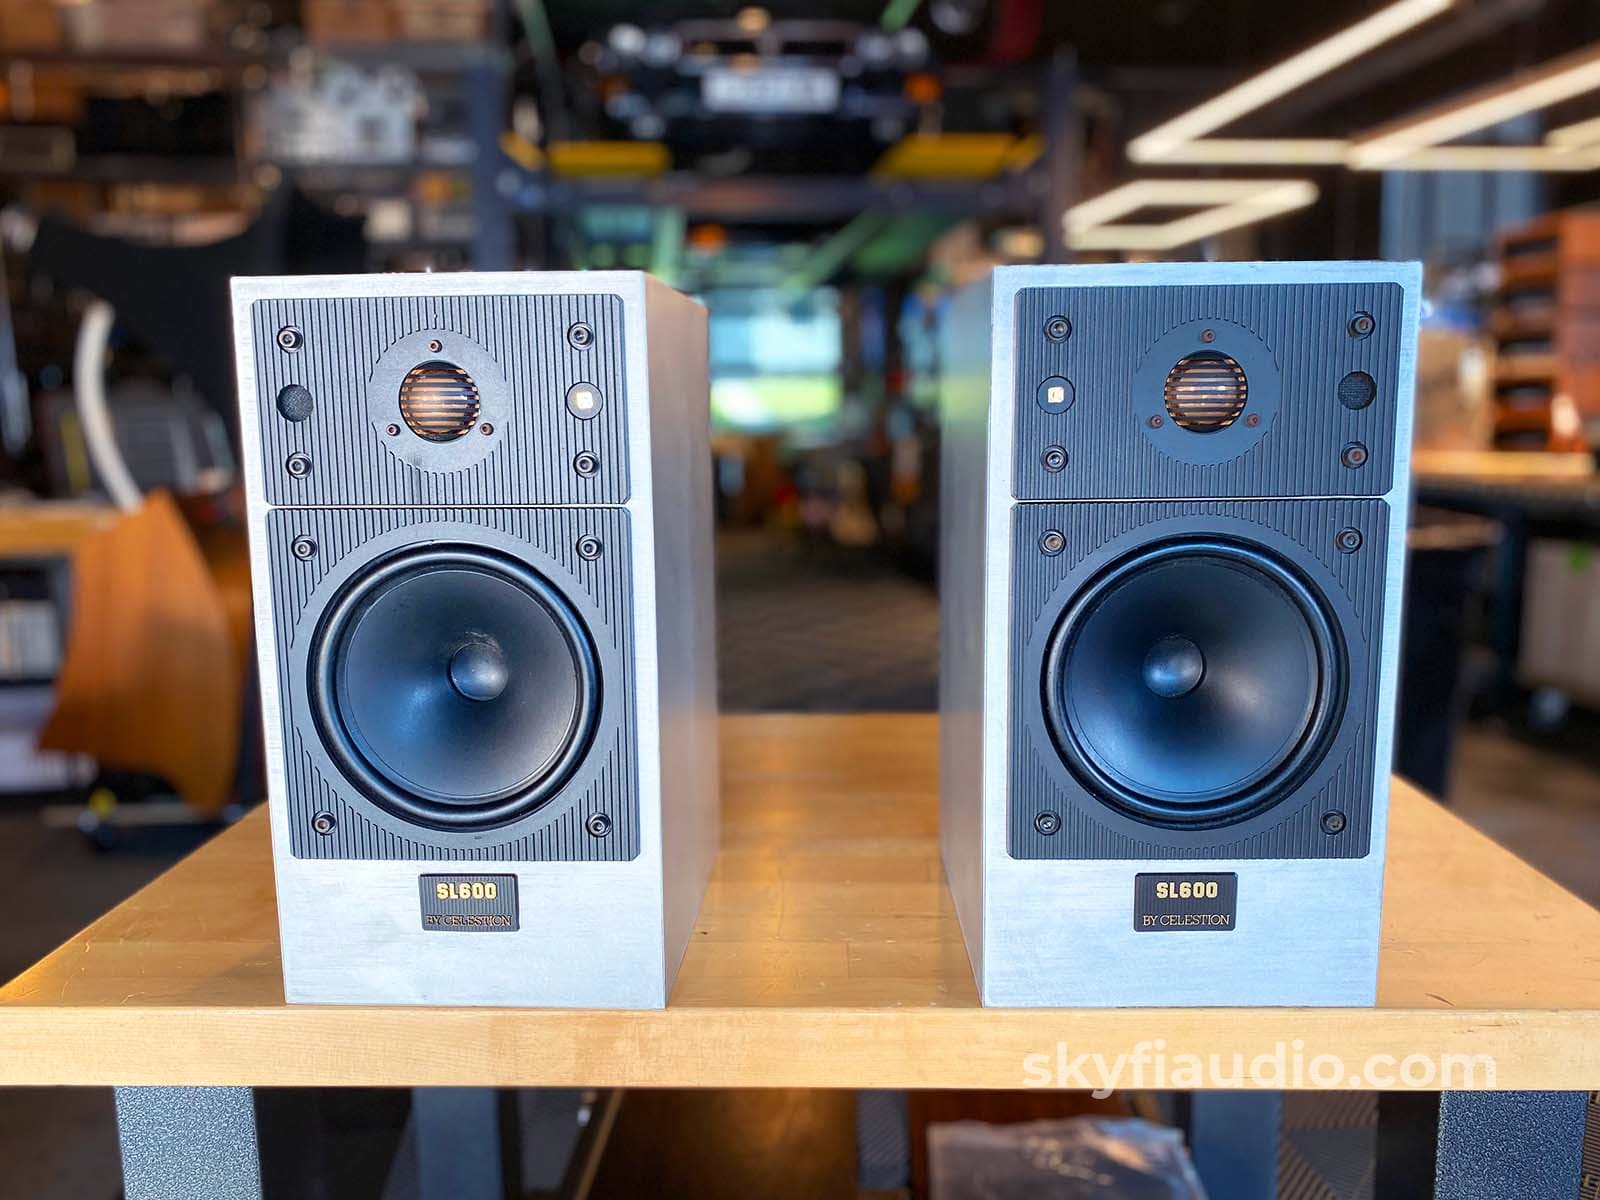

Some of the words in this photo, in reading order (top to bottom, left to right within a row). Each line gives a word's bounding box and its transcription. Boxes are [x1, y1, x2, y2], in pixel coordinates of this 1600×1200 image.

[436, 882, 497, 900] SL600
[1156, 881, 1218, 899] SL600
[426, 914, 442, 926] BY
[444, 914, 512, 927] CELESTION
[1143, 914, 1158, 926] BY
[1159, 914, 1230, 926] CELESTION
